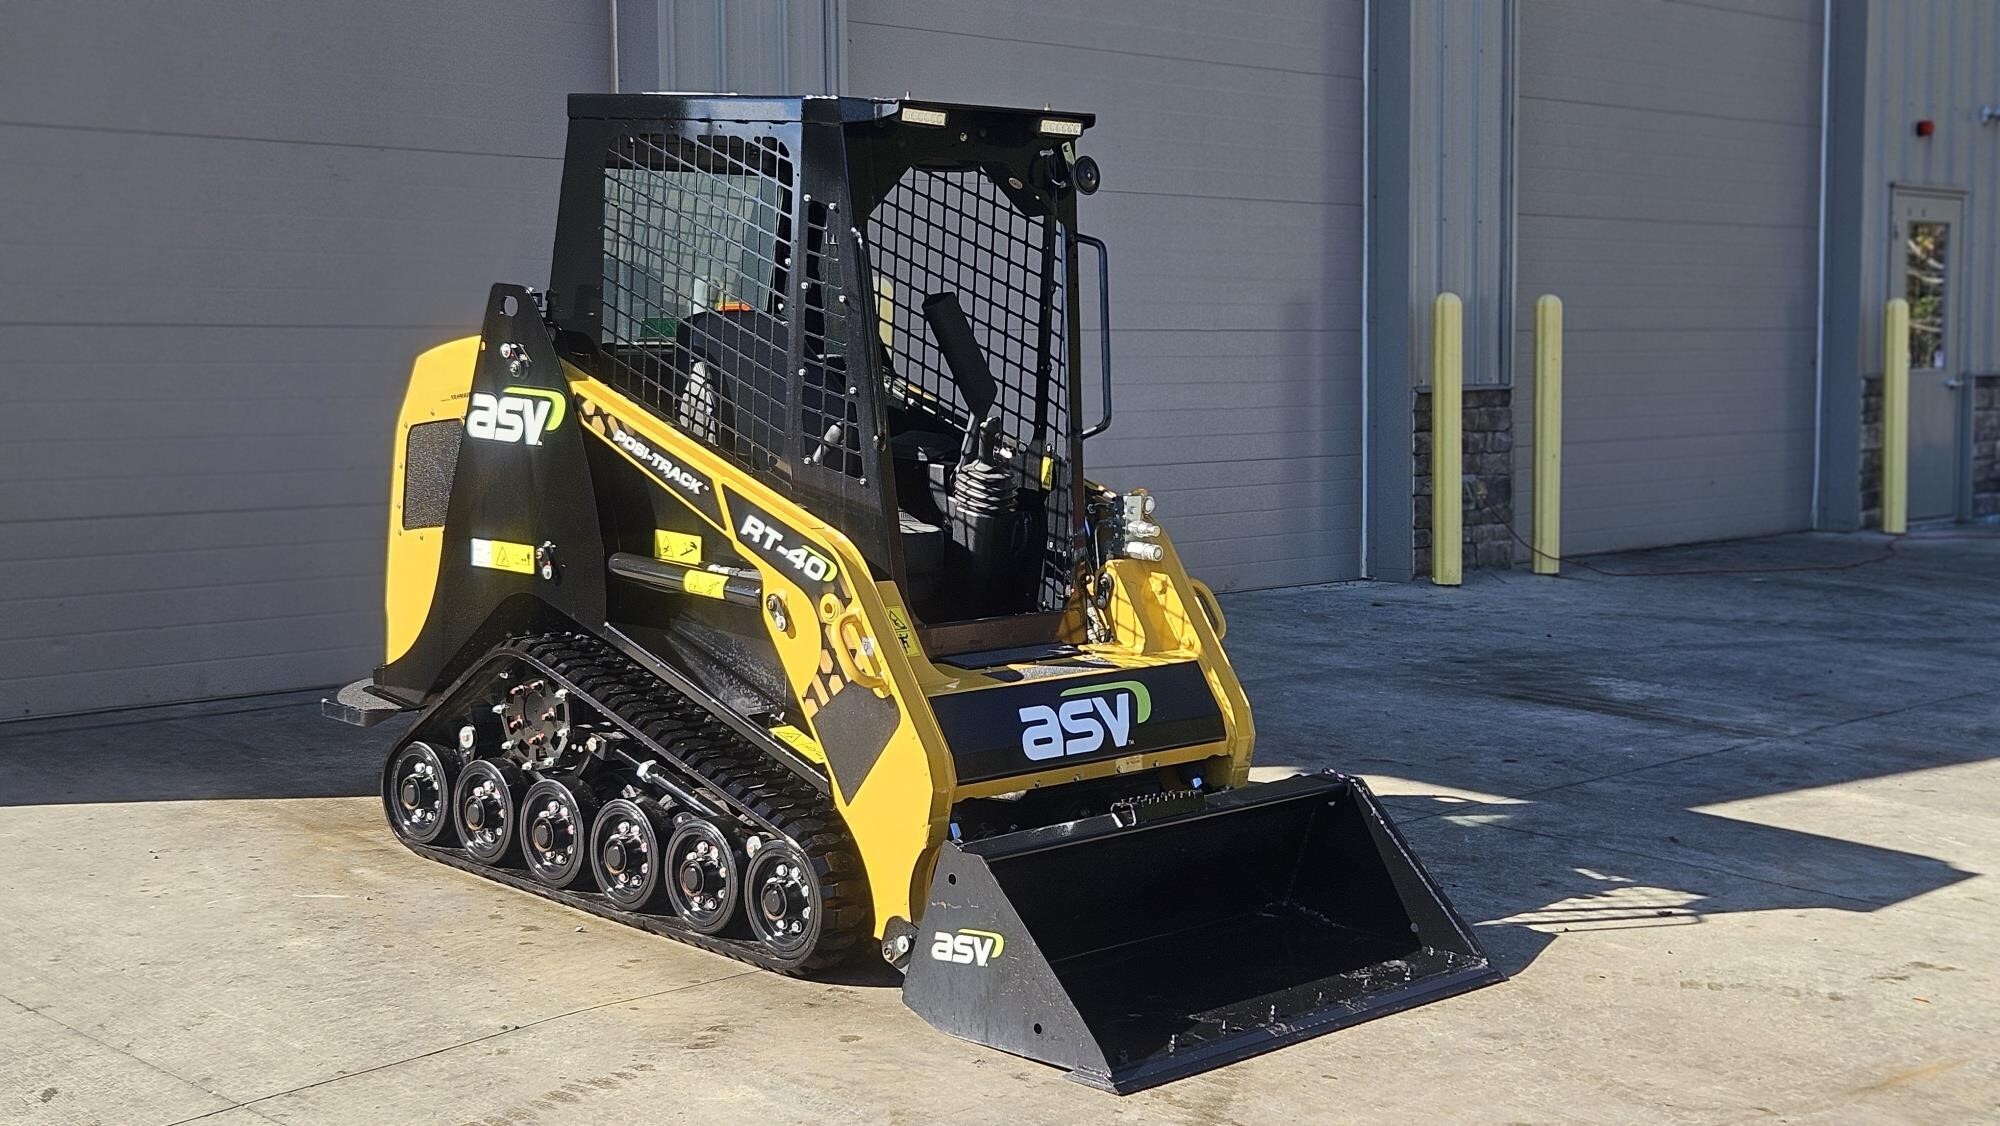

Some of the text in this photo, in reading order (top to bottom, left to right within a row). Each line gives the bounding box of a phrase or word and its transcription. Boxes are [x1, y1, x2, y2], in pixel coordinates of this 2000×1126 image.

[466, 392, 552, 447] asv
[740, 515, 827, 581] RT-40
[1019, 693, 1130, 760] asv
[931, 931, 993, 966] asv
